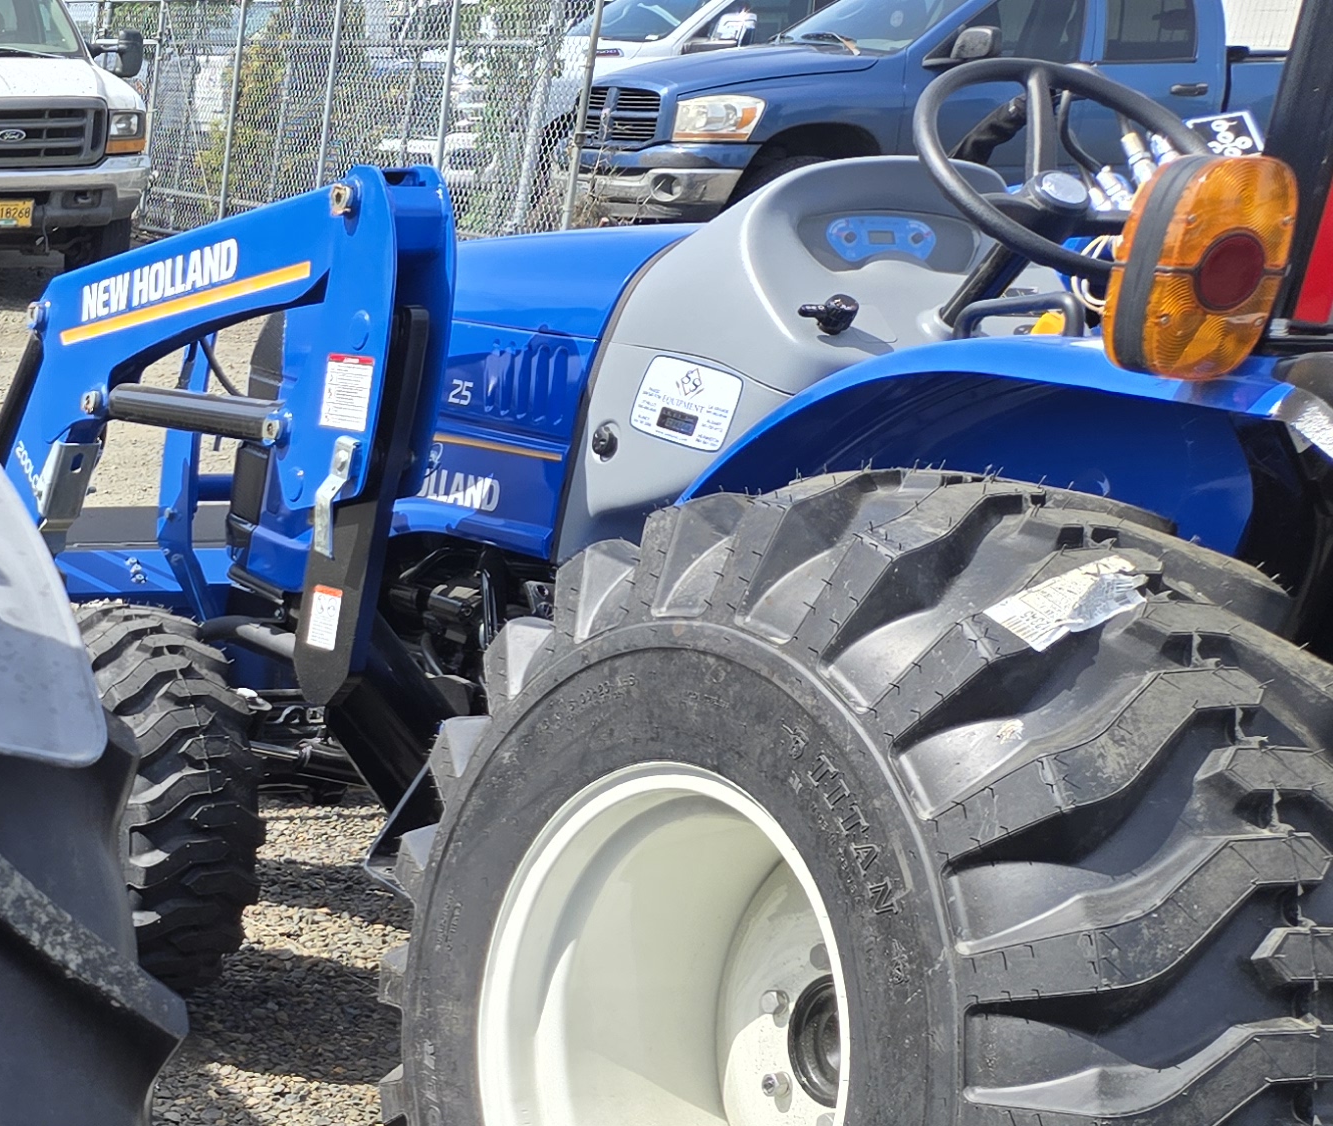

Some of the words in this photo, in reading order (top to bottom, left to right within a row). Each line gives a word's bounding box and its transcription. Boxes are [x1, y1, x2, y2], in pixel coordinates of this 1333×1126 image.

[81, 271, 131, 323] NEW
[132, 238, 239, 307] HOLLAND
[448, 378, 474, 406] 25
[416, 467, 501, 512] LLAND
[807, 754, 899, 915] TITAN
